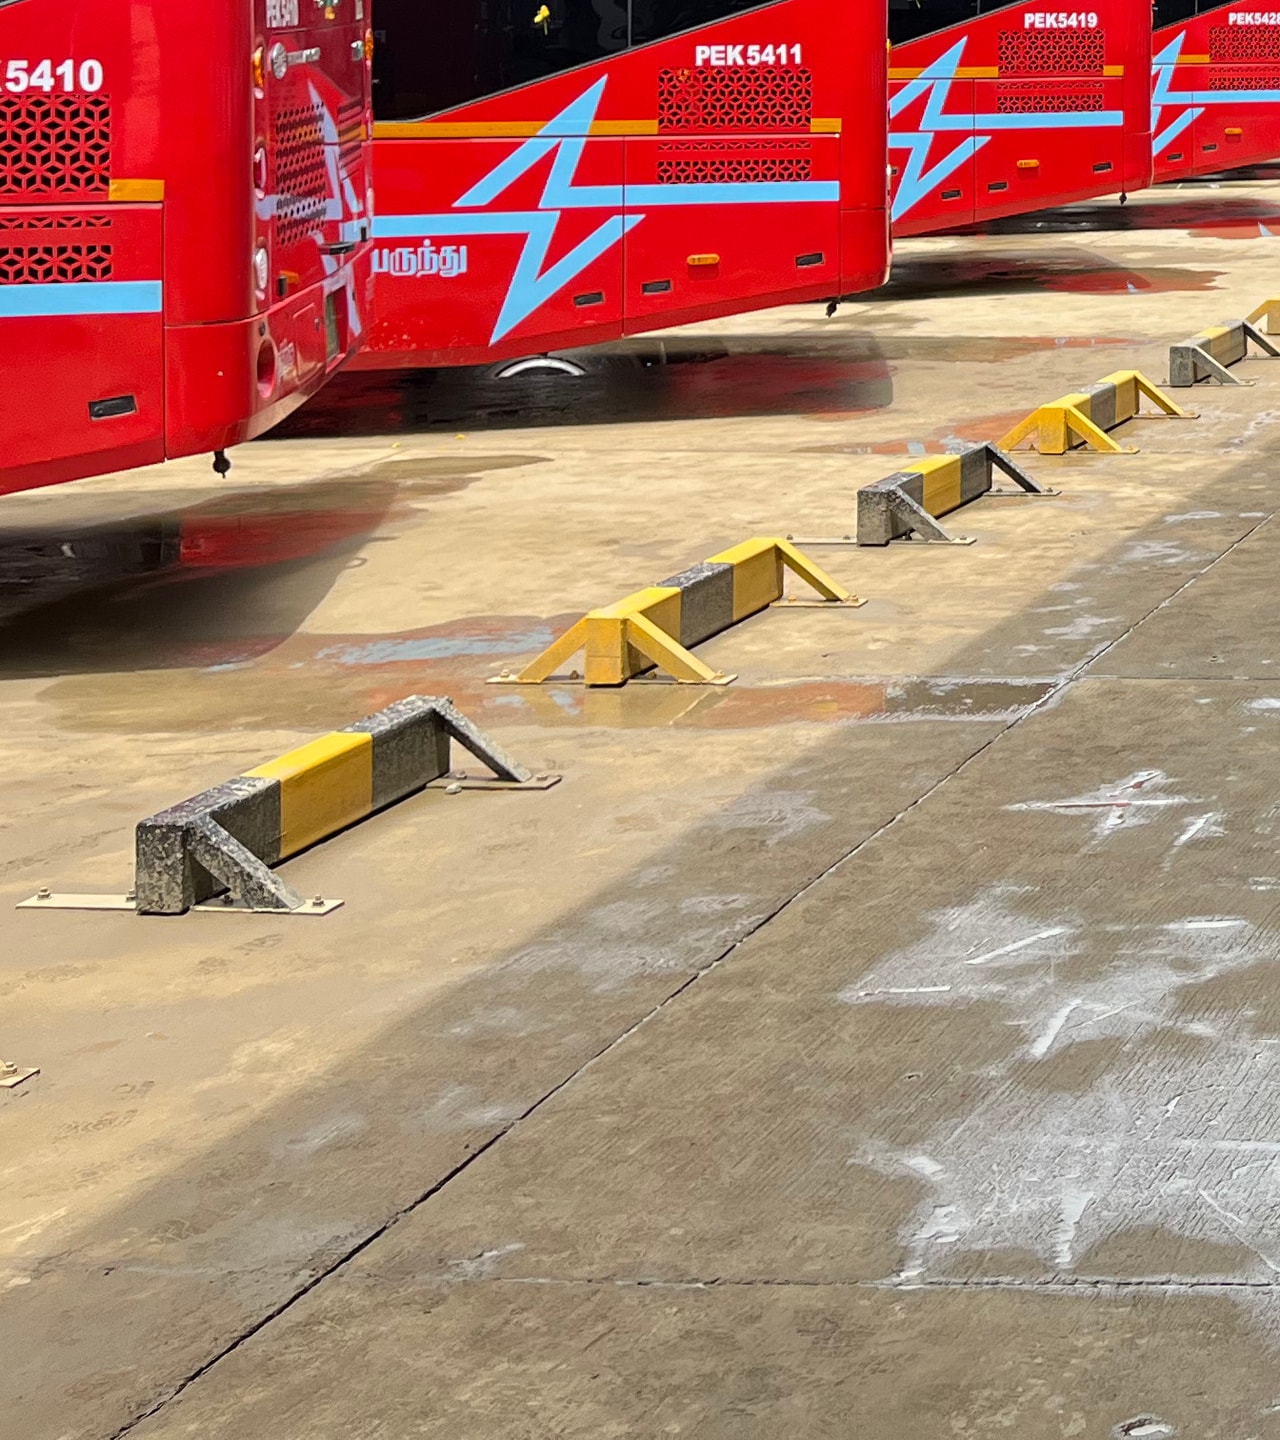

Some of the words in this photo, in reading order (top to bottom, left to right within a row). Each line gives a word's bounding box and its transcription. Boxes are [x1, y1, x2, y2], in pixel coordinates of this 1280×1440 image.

[1024, 12, 1098, 29] PEK5419
[695, 43, 802, 66] PEK5411
[0, 58, 104, 93] 5410
[371, 238, 467, 278] பருந்து
